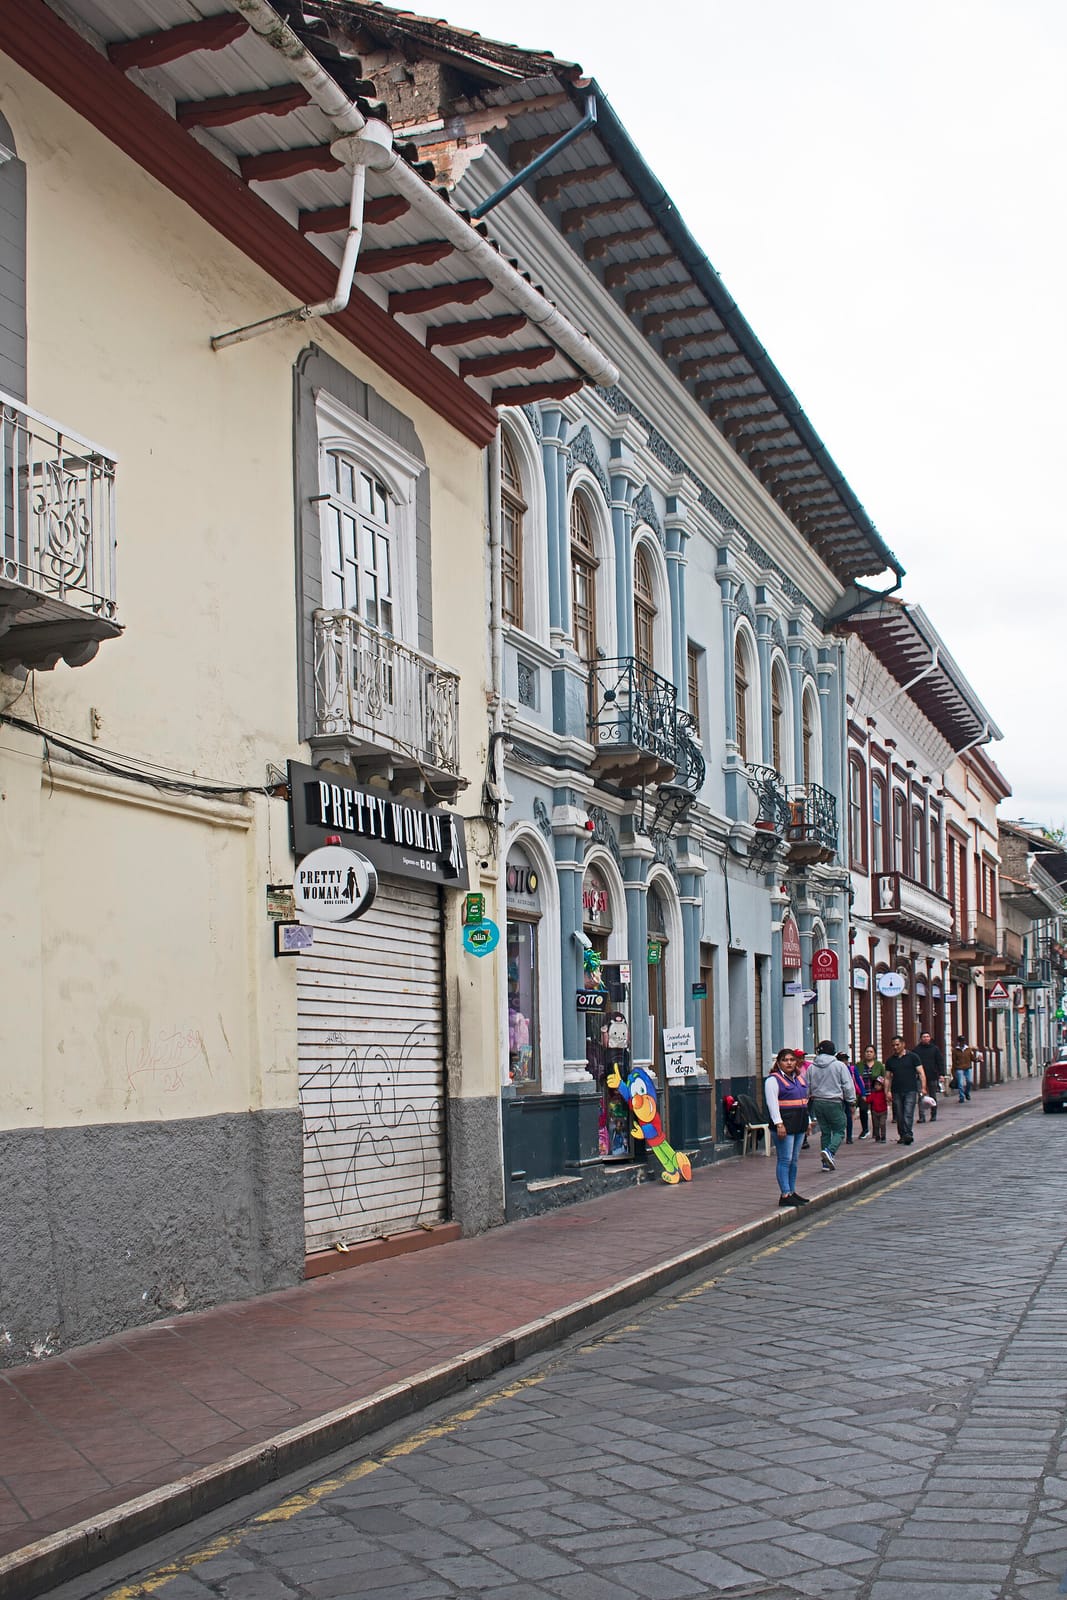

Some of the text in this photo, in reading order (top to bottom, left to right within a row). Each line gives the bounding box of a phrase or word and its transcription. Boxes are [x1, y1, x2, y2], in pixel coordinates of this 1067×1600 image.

[319, 780, 442, 853] PRETTY WOMAN
[300, 870, 342, 884] PRETTY
[302, 886, 340, 900] WOMAN
[670, 1054, 682, 1065] hot
[675, 1064, 694, 1075] dogs
